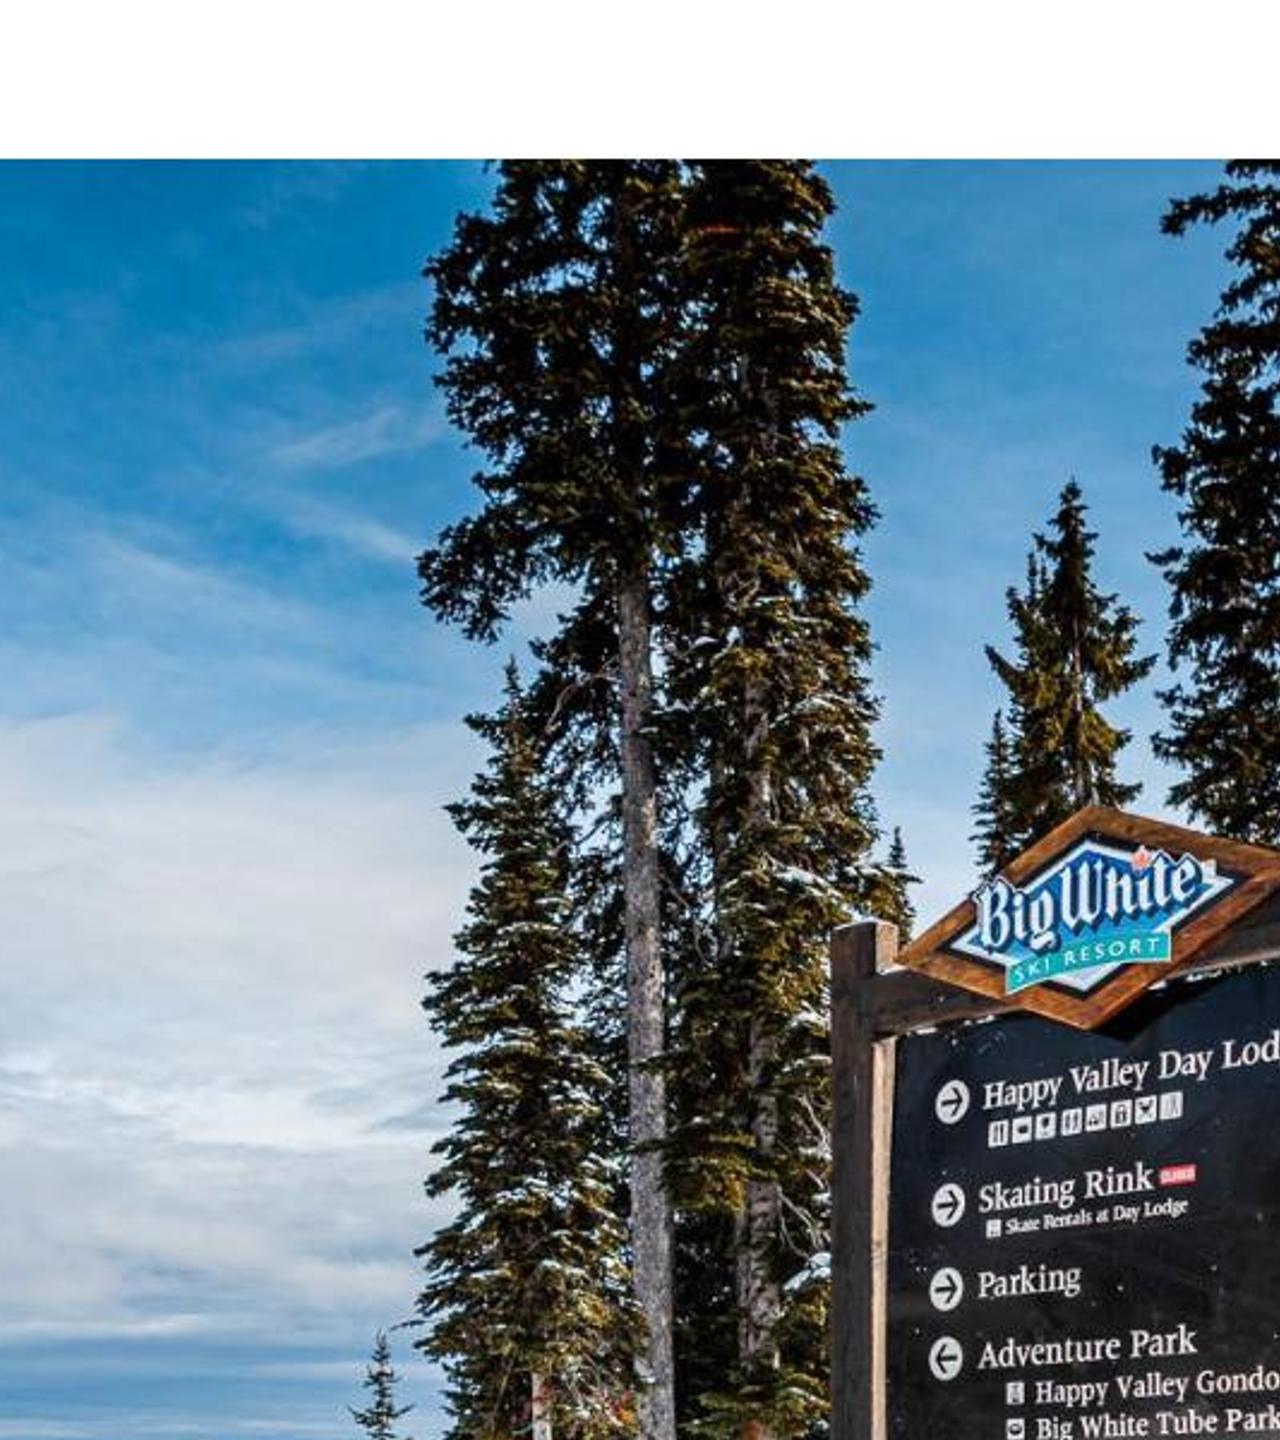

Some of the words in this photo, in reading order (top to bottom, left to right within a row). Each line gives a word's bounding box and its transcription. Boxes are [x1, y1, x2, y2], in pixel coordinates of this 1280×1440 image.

[974, 876, 1058, 951] Big
[1061, 853, 1198, 928] White
[1013, 960, 1051, 984] SKI
[1064, 937, 1160, 966] RESORT
[982, 1077, 1063, 1111] Happy
[1070, 1058, 1150, 1092] Valley
[1158, 1049, 1214, 1081] Day
[978, 1175, 1076, 1213] Skating
[1084, 1161, 1156, 1199] Rink
[1005, 1216, 1040, 1235] Skate
[1043, 1208, 1093, 1229] Rentals
[1095, 1208, 1110, 1223] at
[1113, 1205, 1140, 1224] Day
[1144, 1197, 1189, 1218] Lodge
[977, 1264, 1083, 1298] Parking
[977, 1337, 1121, 1370] Adventure
[1129, 1323, 1198, 1358] Park
[1034, 1380, 1109, 1408] Happy
[1114, 1372, 1189, 1402] Valley
[1080, 1411, 1149, 1439] White
[1156, 1408, 1219, 1435] Tube
